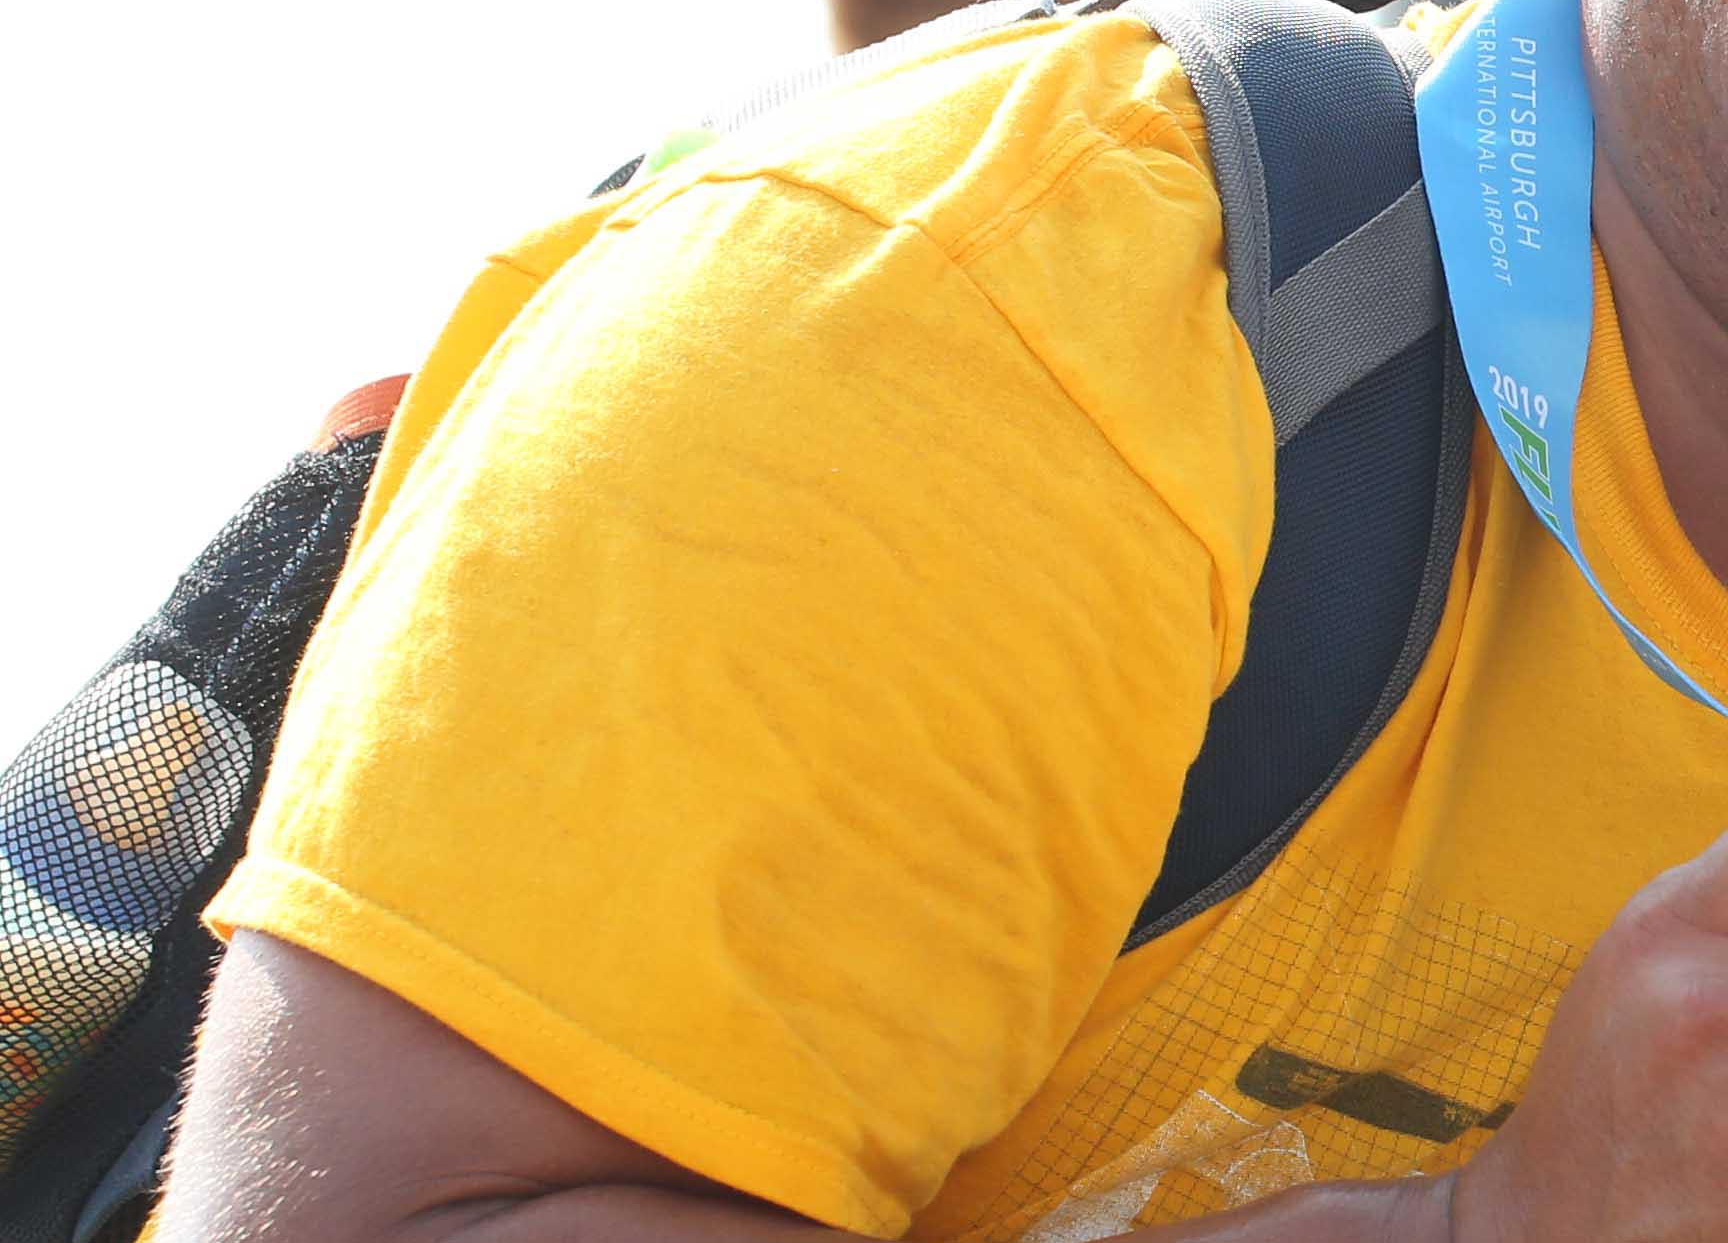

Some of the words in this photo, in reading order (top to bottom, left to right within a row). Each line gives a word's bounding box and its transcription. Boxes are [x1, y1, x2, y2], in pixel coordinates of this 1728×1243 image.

[1509, 36, 1542, 250] PITTSBURGH
[1480, 182, 1513, 287] AIRPORT
[1488, 365, 1548, 429] 2019
